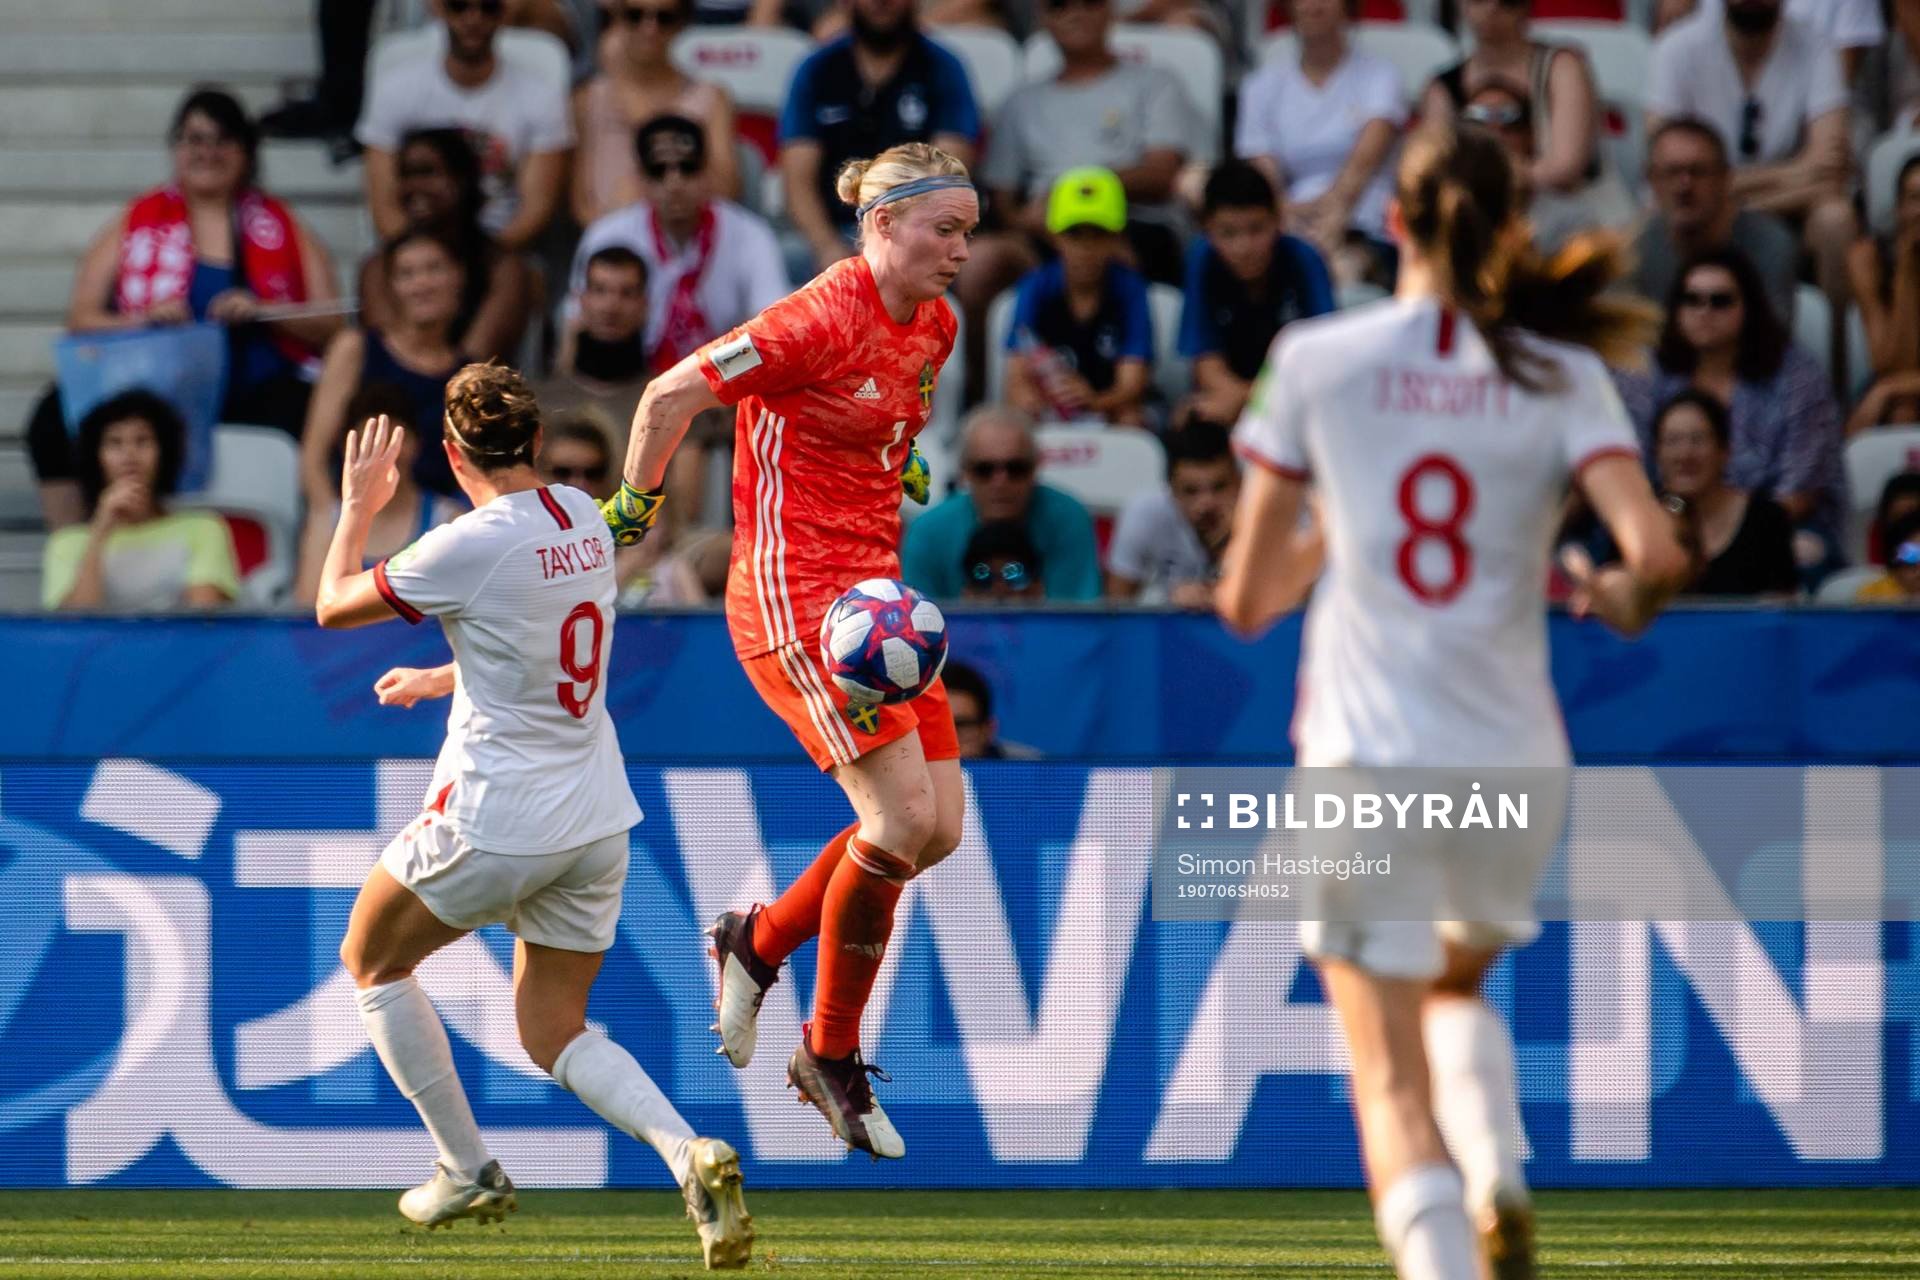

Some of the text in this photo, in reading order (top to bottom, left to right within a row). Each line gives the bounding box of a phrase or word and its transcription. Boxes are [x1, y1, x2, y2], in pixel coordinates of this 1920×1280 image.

[854, 391, 881, 399] adidas
[881, 421, 907, 471] 1
[1395, 452, 1477, 607] 8
[536, 537, 607, 580] TAYLOR
[557, 601, 604, 719] 9
